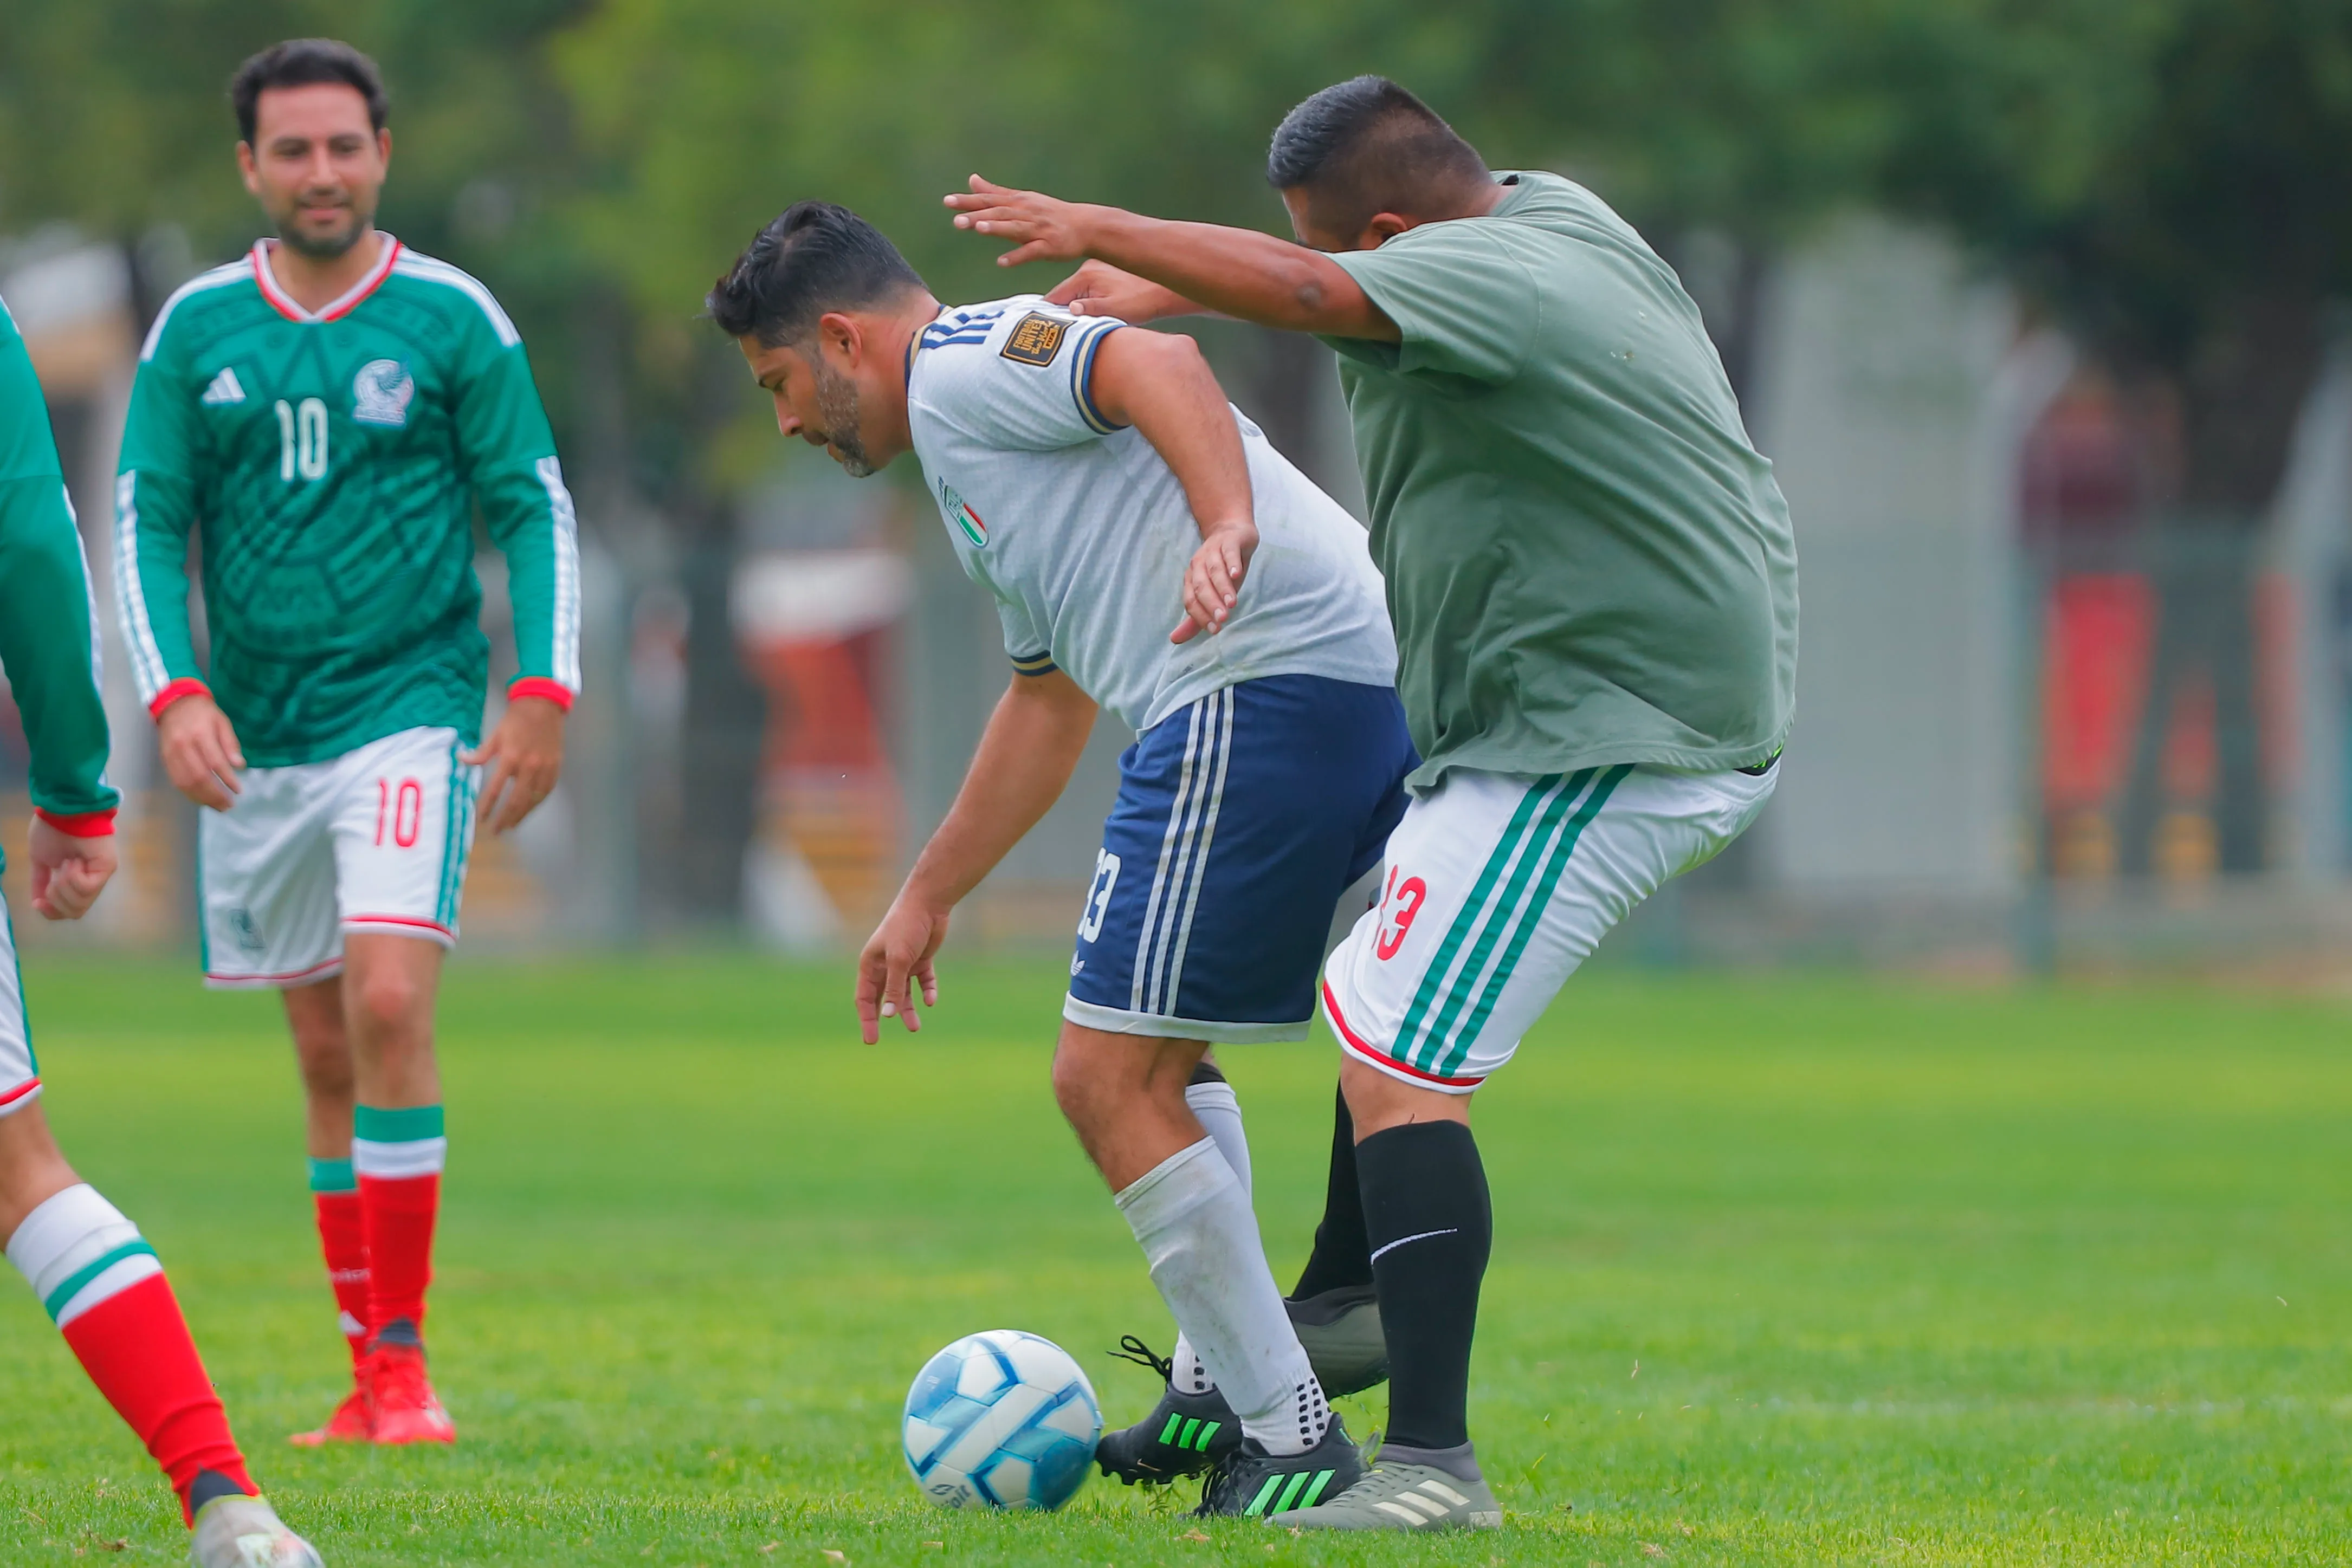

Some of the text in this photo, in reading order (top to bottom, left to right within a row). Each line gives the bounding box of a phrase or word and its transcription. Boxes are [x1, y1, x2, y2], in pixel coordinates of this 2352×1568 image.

[1012, 319, 1035, 348] FOOTBALL
[1019, 319, 1043, 351] UNITES
[1045, 331, 1056, 347] FIFA
[275, 397, 328, 482] 10
[375, 777, 423, 849] 10
